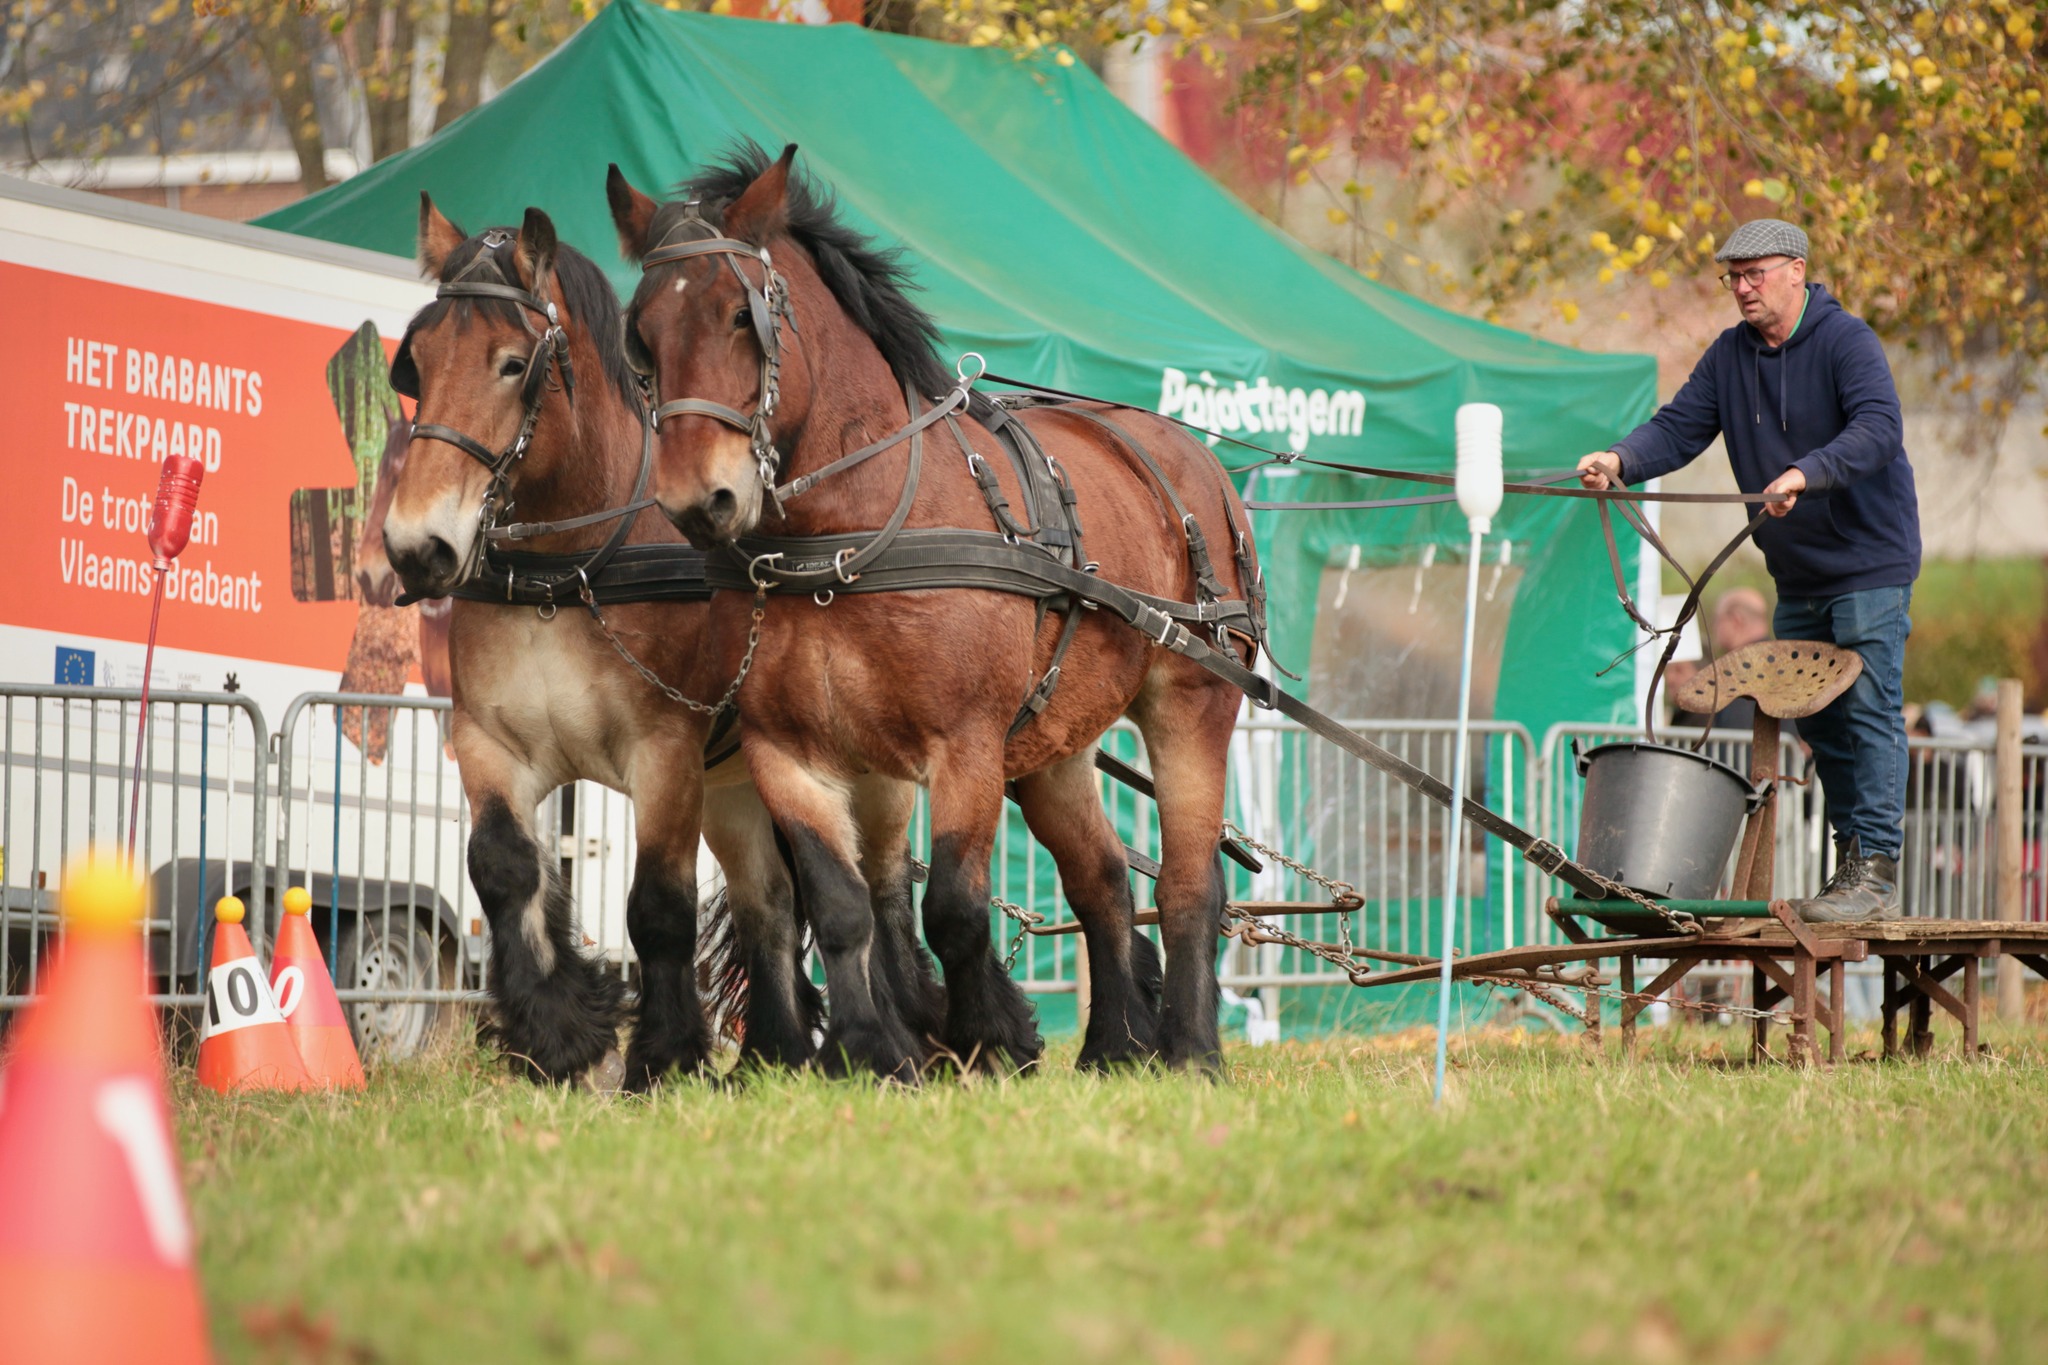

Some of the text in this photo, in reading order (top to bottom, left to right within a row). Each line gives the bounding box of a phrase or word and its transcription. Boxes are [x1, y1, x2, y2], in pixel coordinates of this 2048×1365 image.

[66, 336, 263, 418] HET BRABANTS
[1157, 366, 1366, 452] Pajottegem
[64, 401, 222, 474] TREKPAARD
[62, 476, 219, 547] De trot an
[60, 536, 263, 614] Vlaams-Brabant
